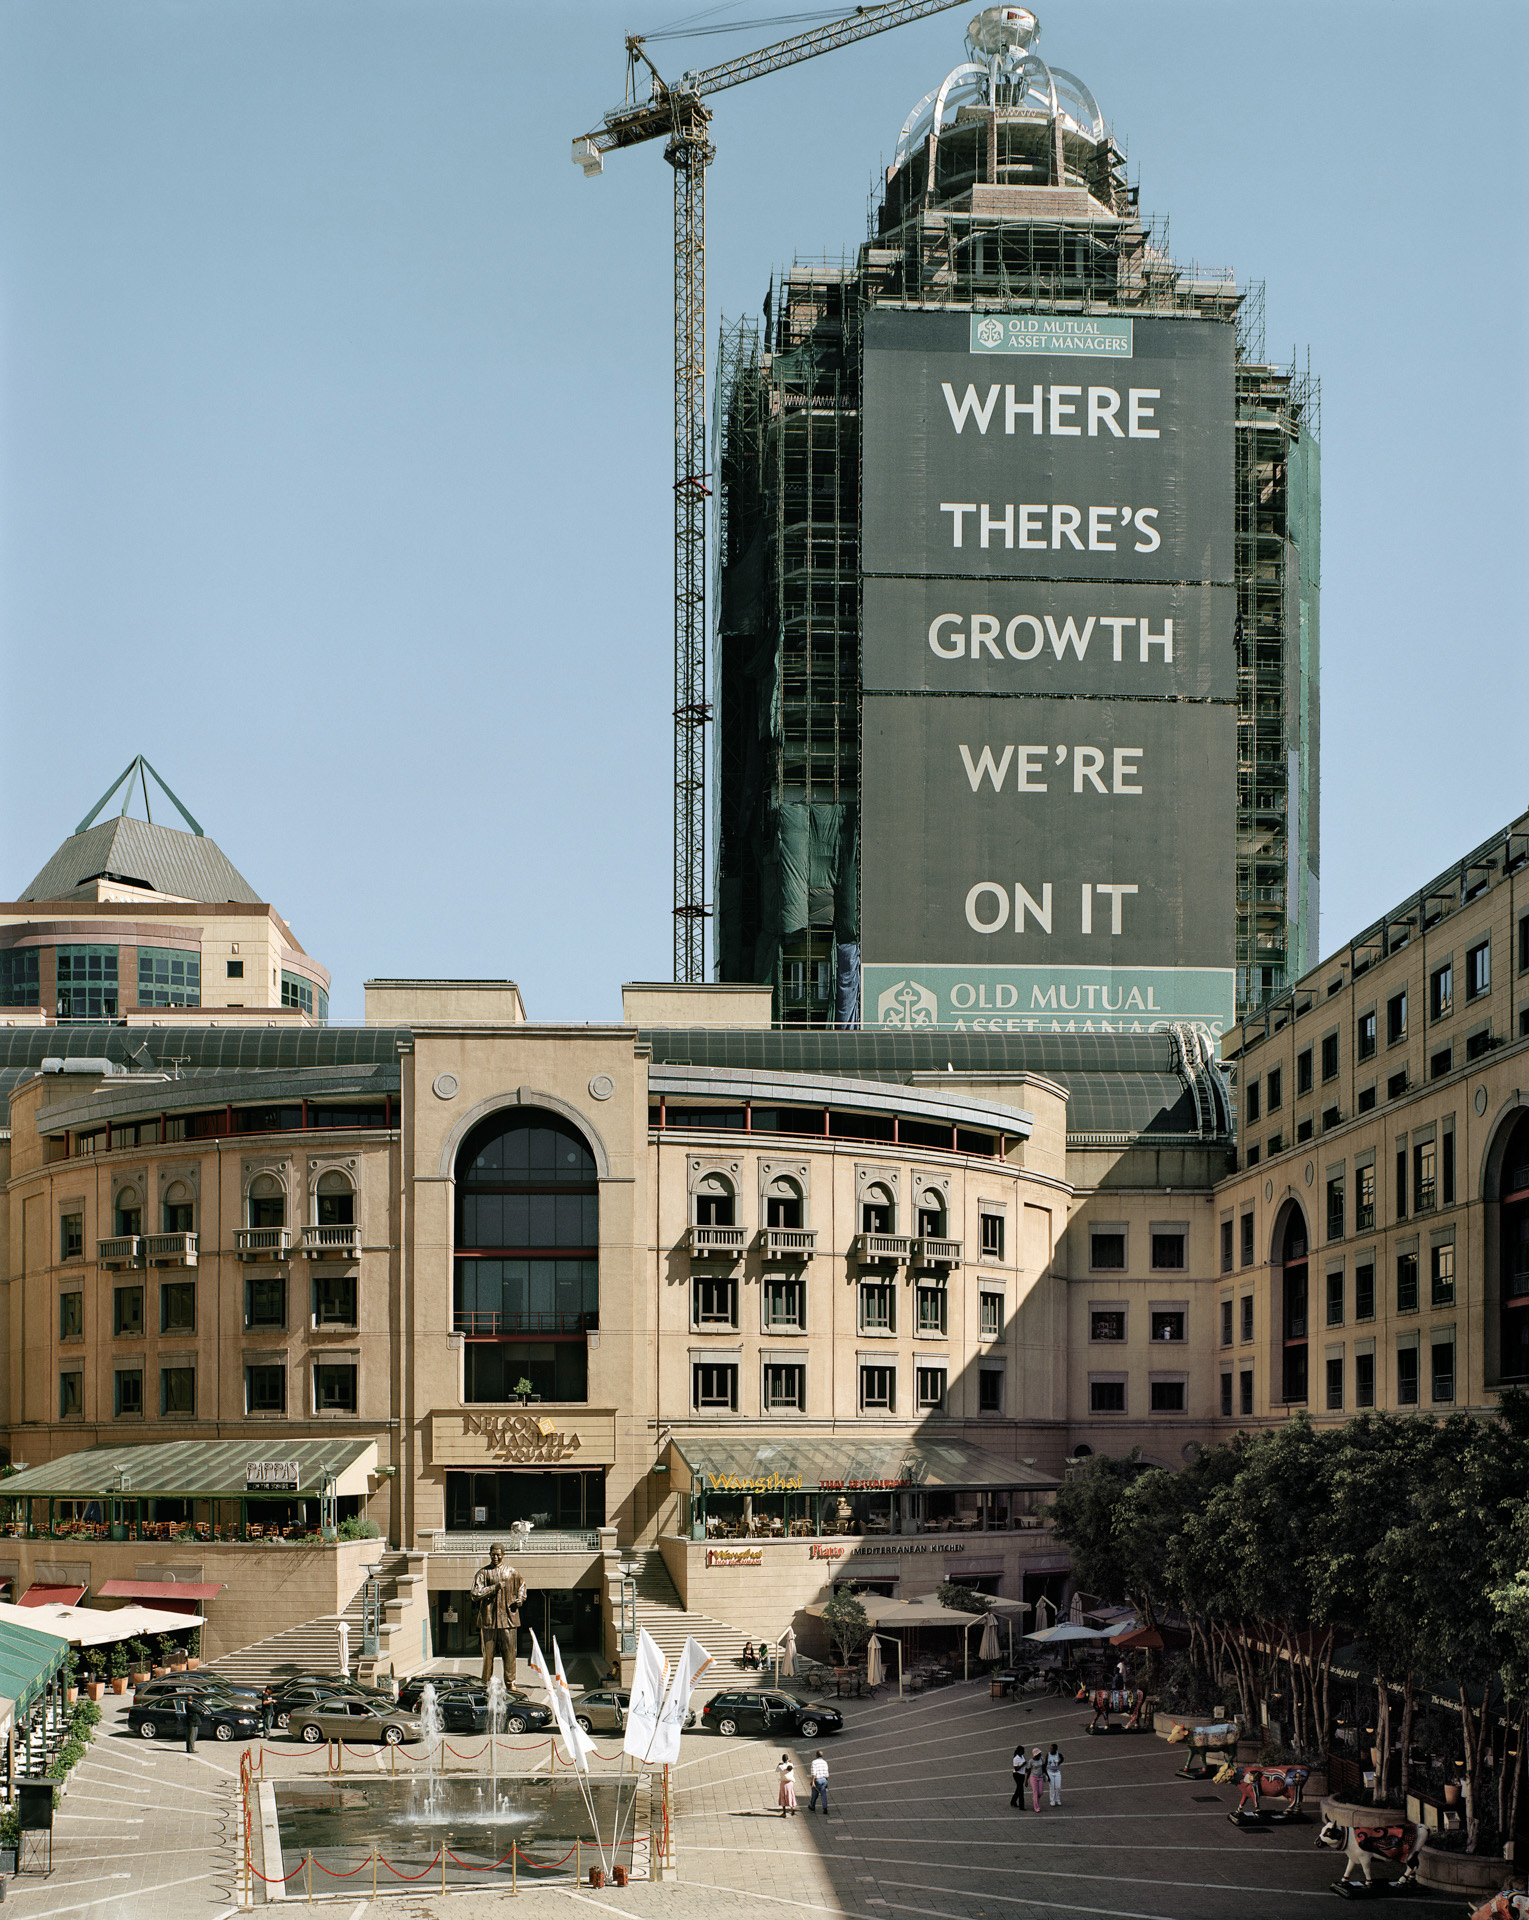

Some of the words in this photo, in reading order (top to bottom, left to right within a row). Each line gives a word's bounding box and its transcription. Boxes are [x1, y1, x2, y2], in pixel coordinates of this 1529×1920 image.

[1008, 319, 1039, 332] OLD
[1043, 321, 1101, 334] MUTUAL
[1008, 335, 1048, 348] ASSET
[1051, 336, 1128, 351] MANAGERS
[941, 382, 1161, 439] WHERE
[939, 503, 1161, 553] THERE'S
[928, 613, 1173, 663] GROWTH
[958, 744, 1144, 794] WE'RE
[965, 881, 1052, 934] ON
[1081, 883, 1139, 935] IT
[950, 983, 1018, 1009] OLD
[1030, 984, 1161, 1011] MUTUAL
[464, 1413, 541, 1433] NELSON
[487, 1430, 581, 1448] MANDELA
[505, 1449, 563, 1461] SQUARE
[247, 1462, 298, 1481] PAPPAS
[707, 1471, 803, 1494] Wangthai
[819, 1480, 845, 1489] THAI
[848, 1479, 913, 1489] RESTAURANT
[812, 1544, 845, 1557] Piatto
[852, 1545, 927, 1555] MEDITERRANEAN
[930, 1544, 965, 1553] KITCHEN
